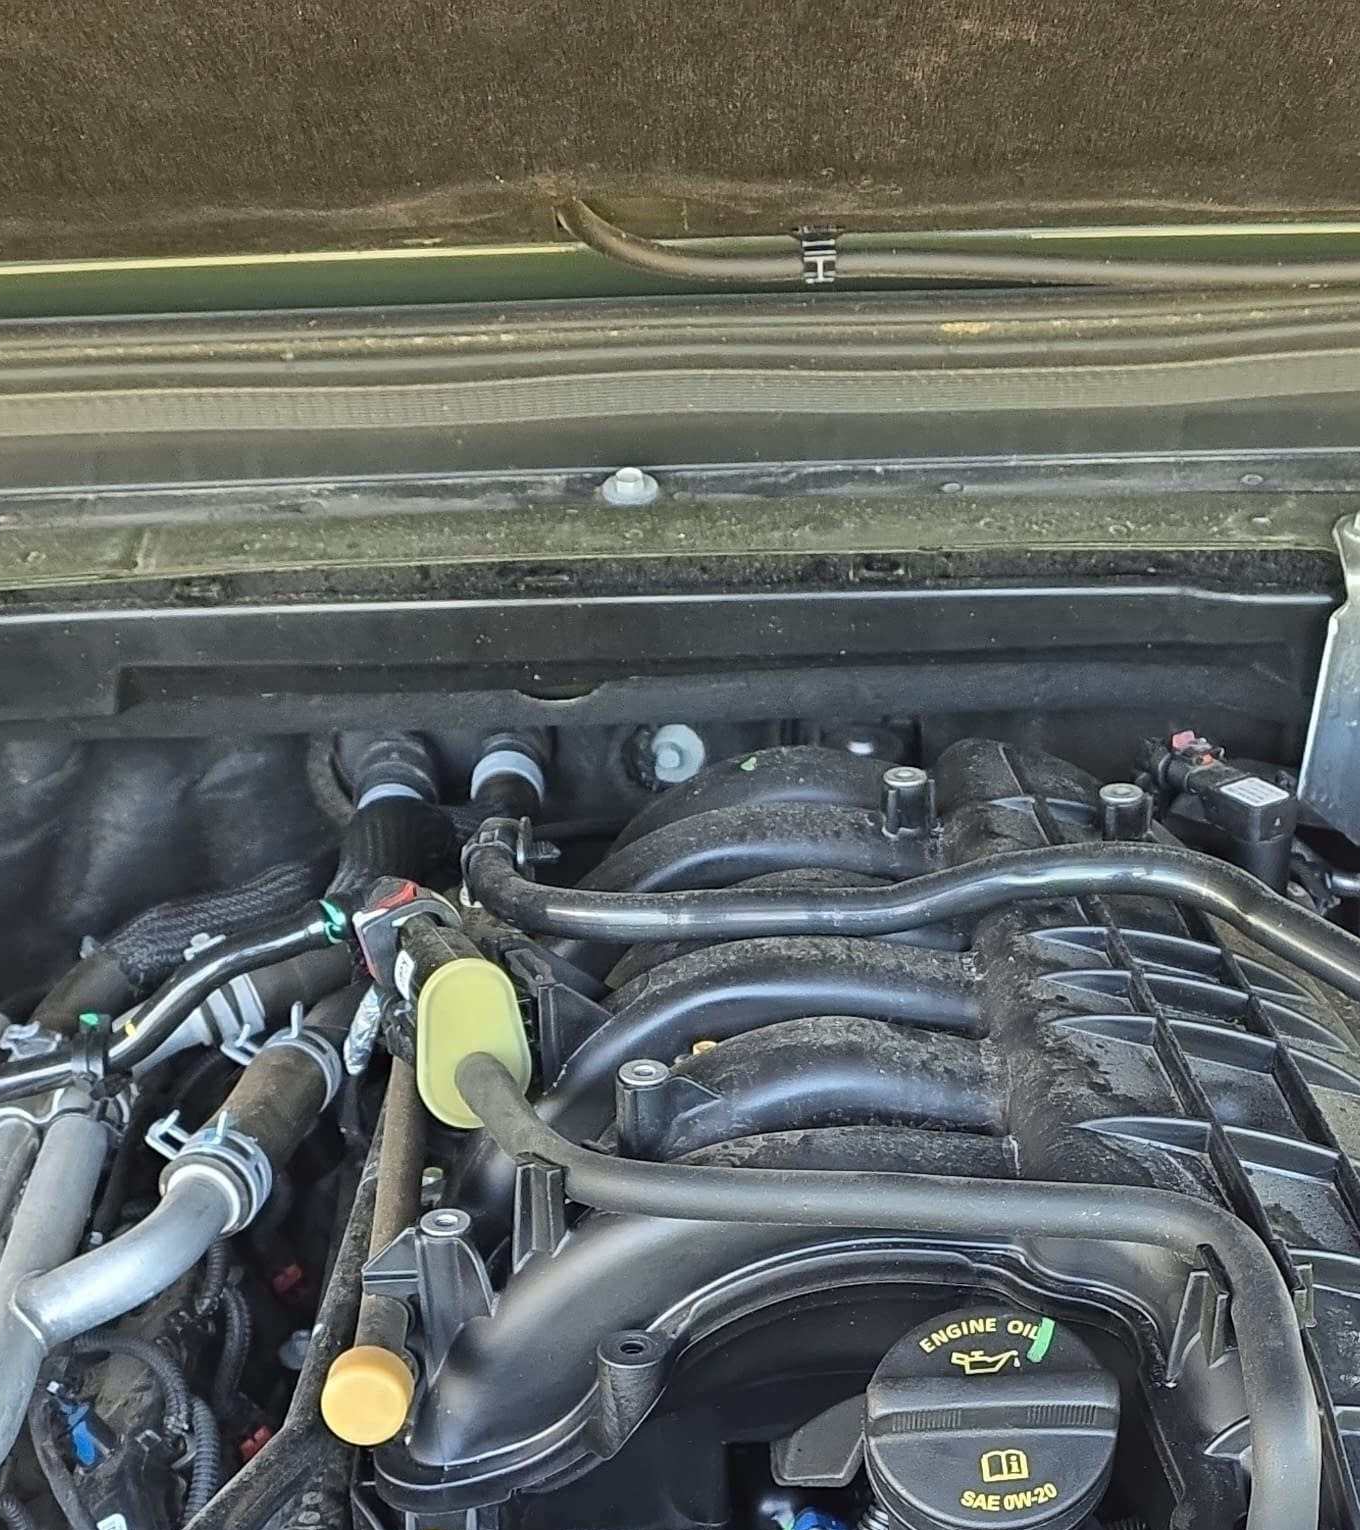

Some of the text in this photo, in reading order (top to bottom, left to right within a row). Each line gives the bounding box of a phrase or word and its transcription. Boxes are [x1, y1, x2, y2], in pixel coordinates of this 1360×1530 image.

[919, 1318, 1042, 1353] ENGINE OIL
[960, 1483, 1057, 1511] SAE 0W-20
